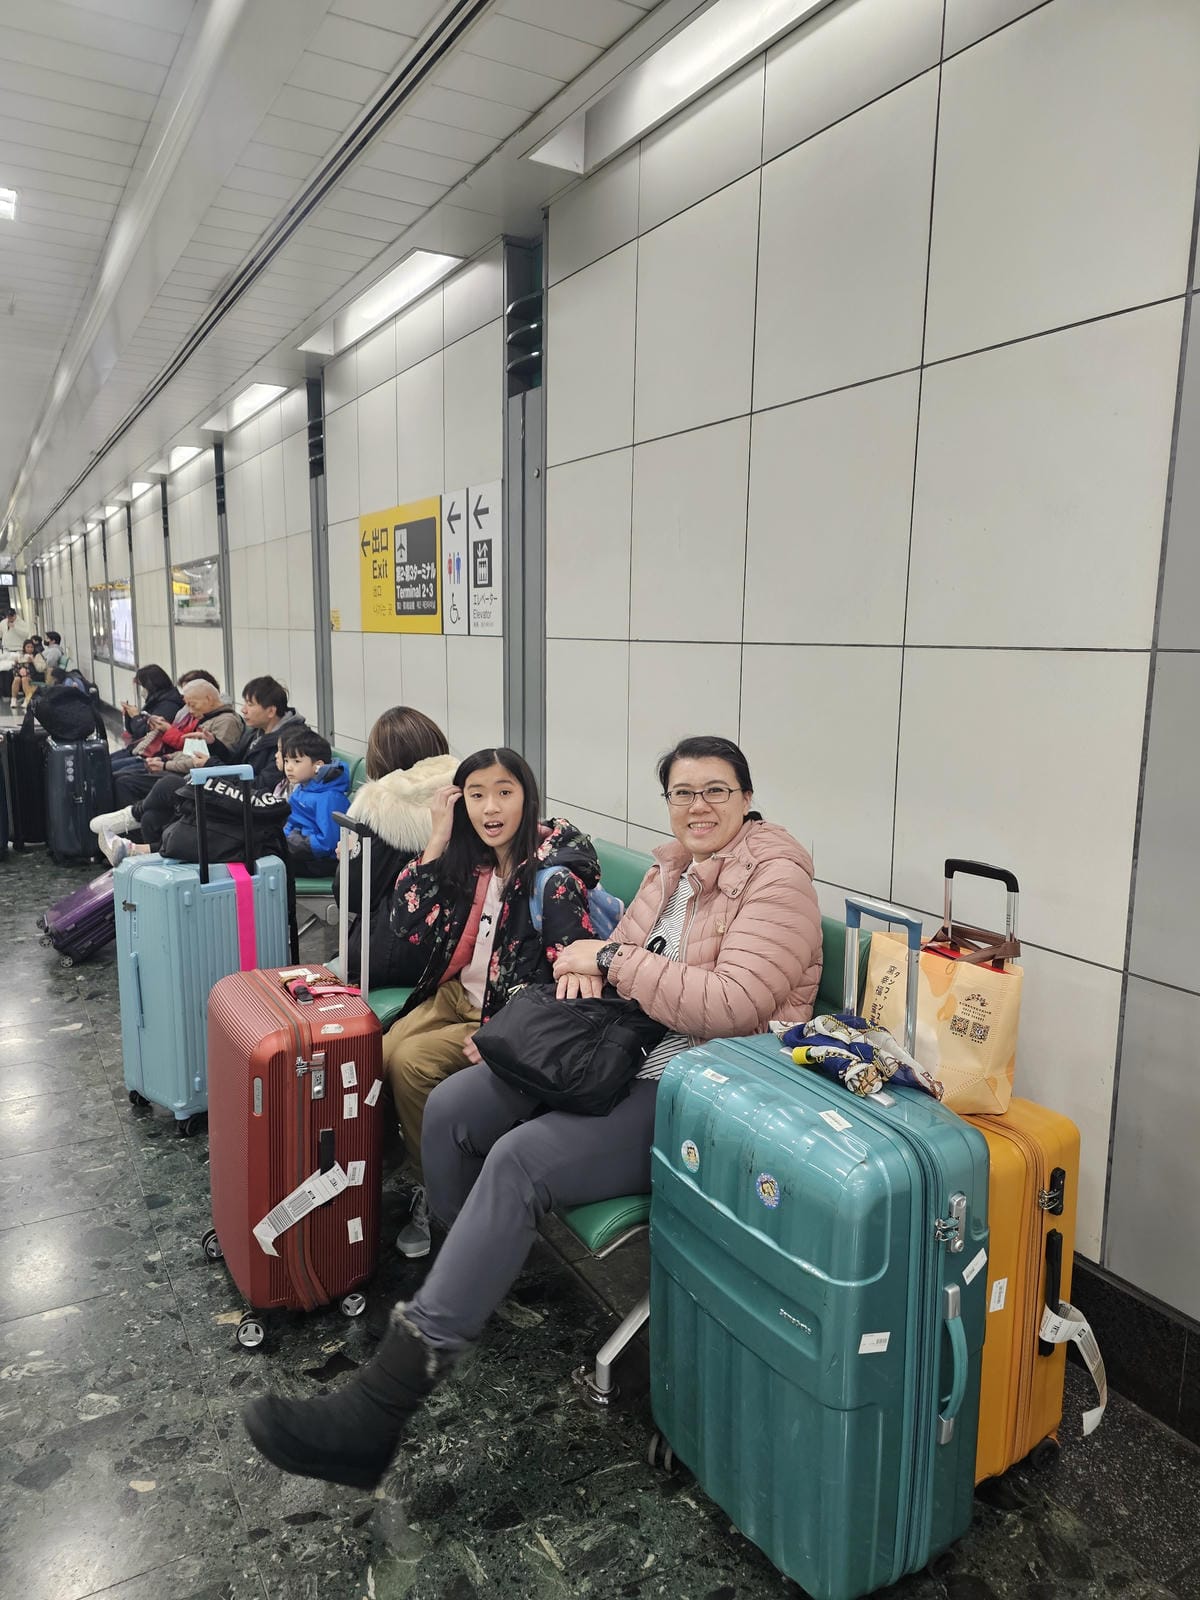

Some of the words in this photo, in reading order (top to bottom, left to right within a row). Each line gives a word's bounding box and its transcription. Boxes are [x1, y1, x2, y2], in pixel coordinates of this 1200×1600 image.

[372, 528, 389, 554] 出口
[372, 559, 388, 580] Exit
[396, 583, 421, 599] Terminal
[473, 609, 492, 619] Elevator
